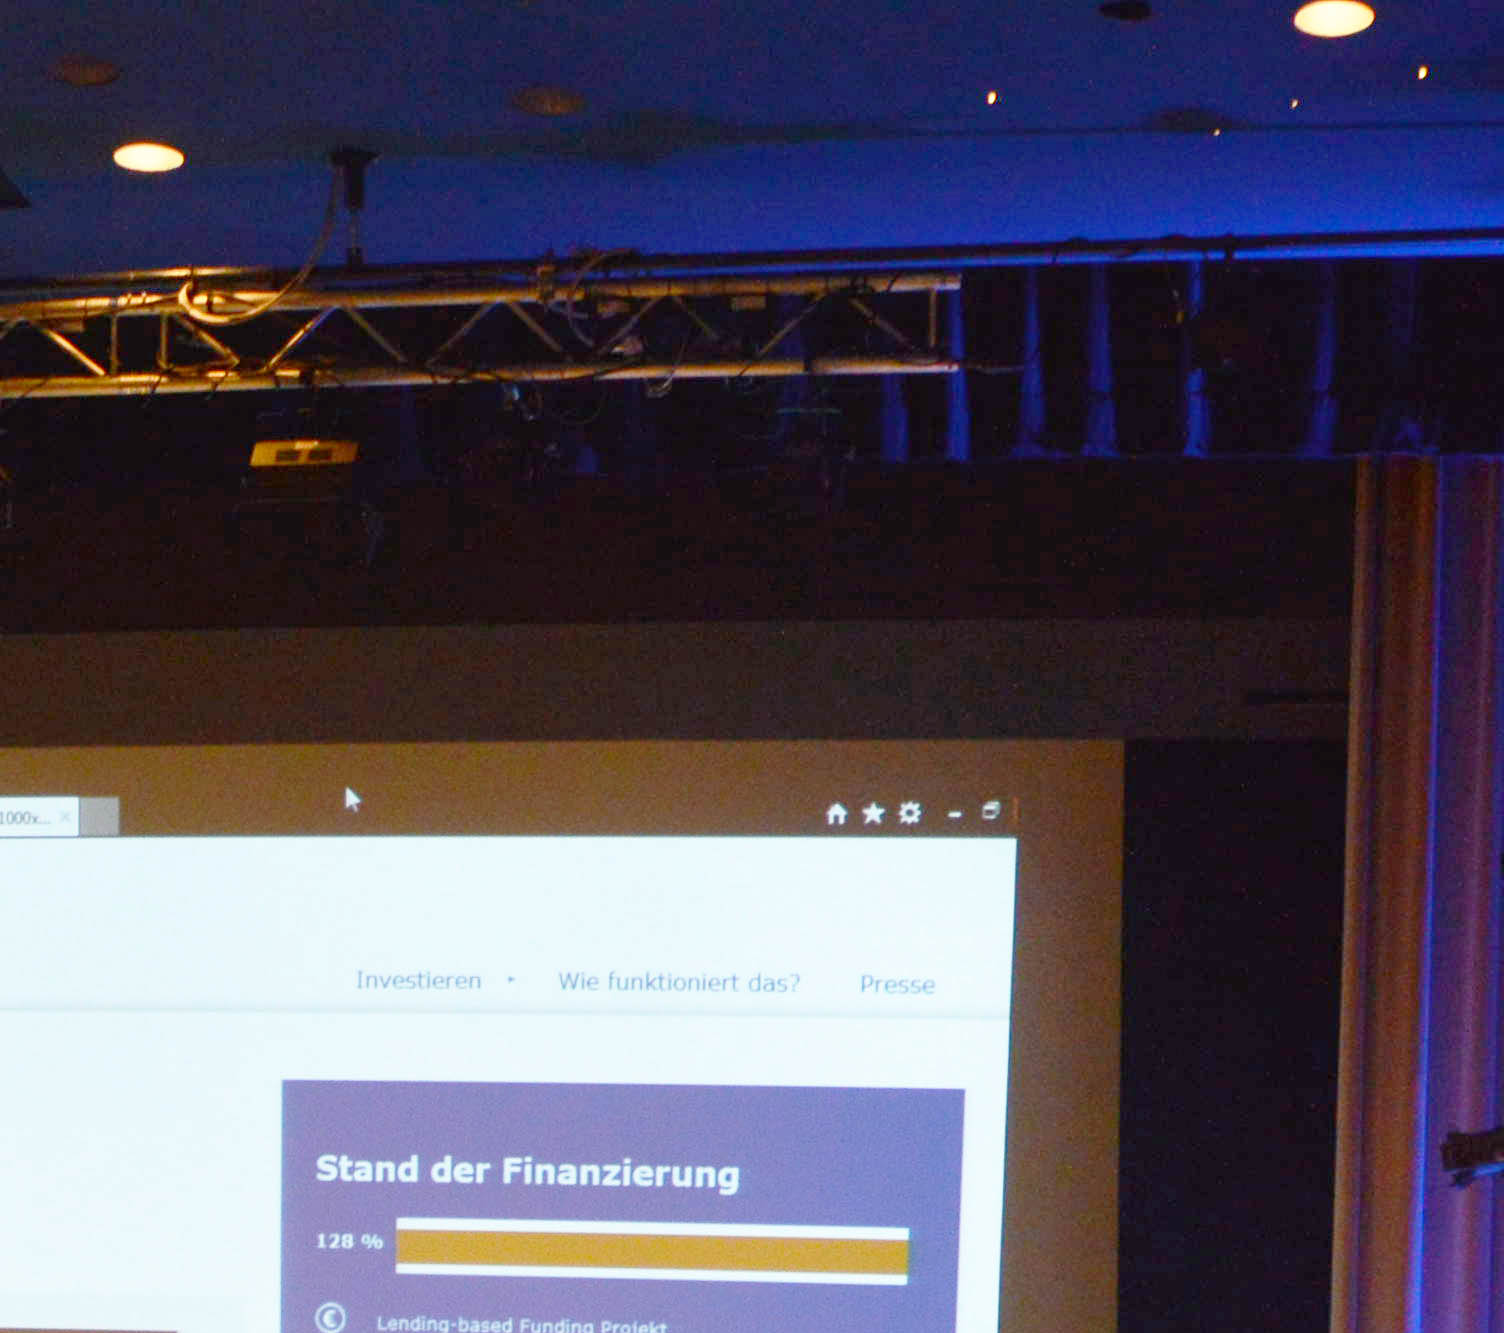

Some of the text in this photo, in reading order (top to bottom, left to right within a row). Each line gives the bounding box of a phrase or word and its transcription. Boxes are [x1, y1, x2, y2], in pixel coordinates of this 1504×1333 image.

[356, 968, 482, 991] Investieren
[558, 970, 801, 994] Wie funktioniert das?
[860, 974, 936, 995] Presse
[315, 1153, 741, 1195] Stand der Finanzierung
[315, 1232, 385, 1251] 128 %
